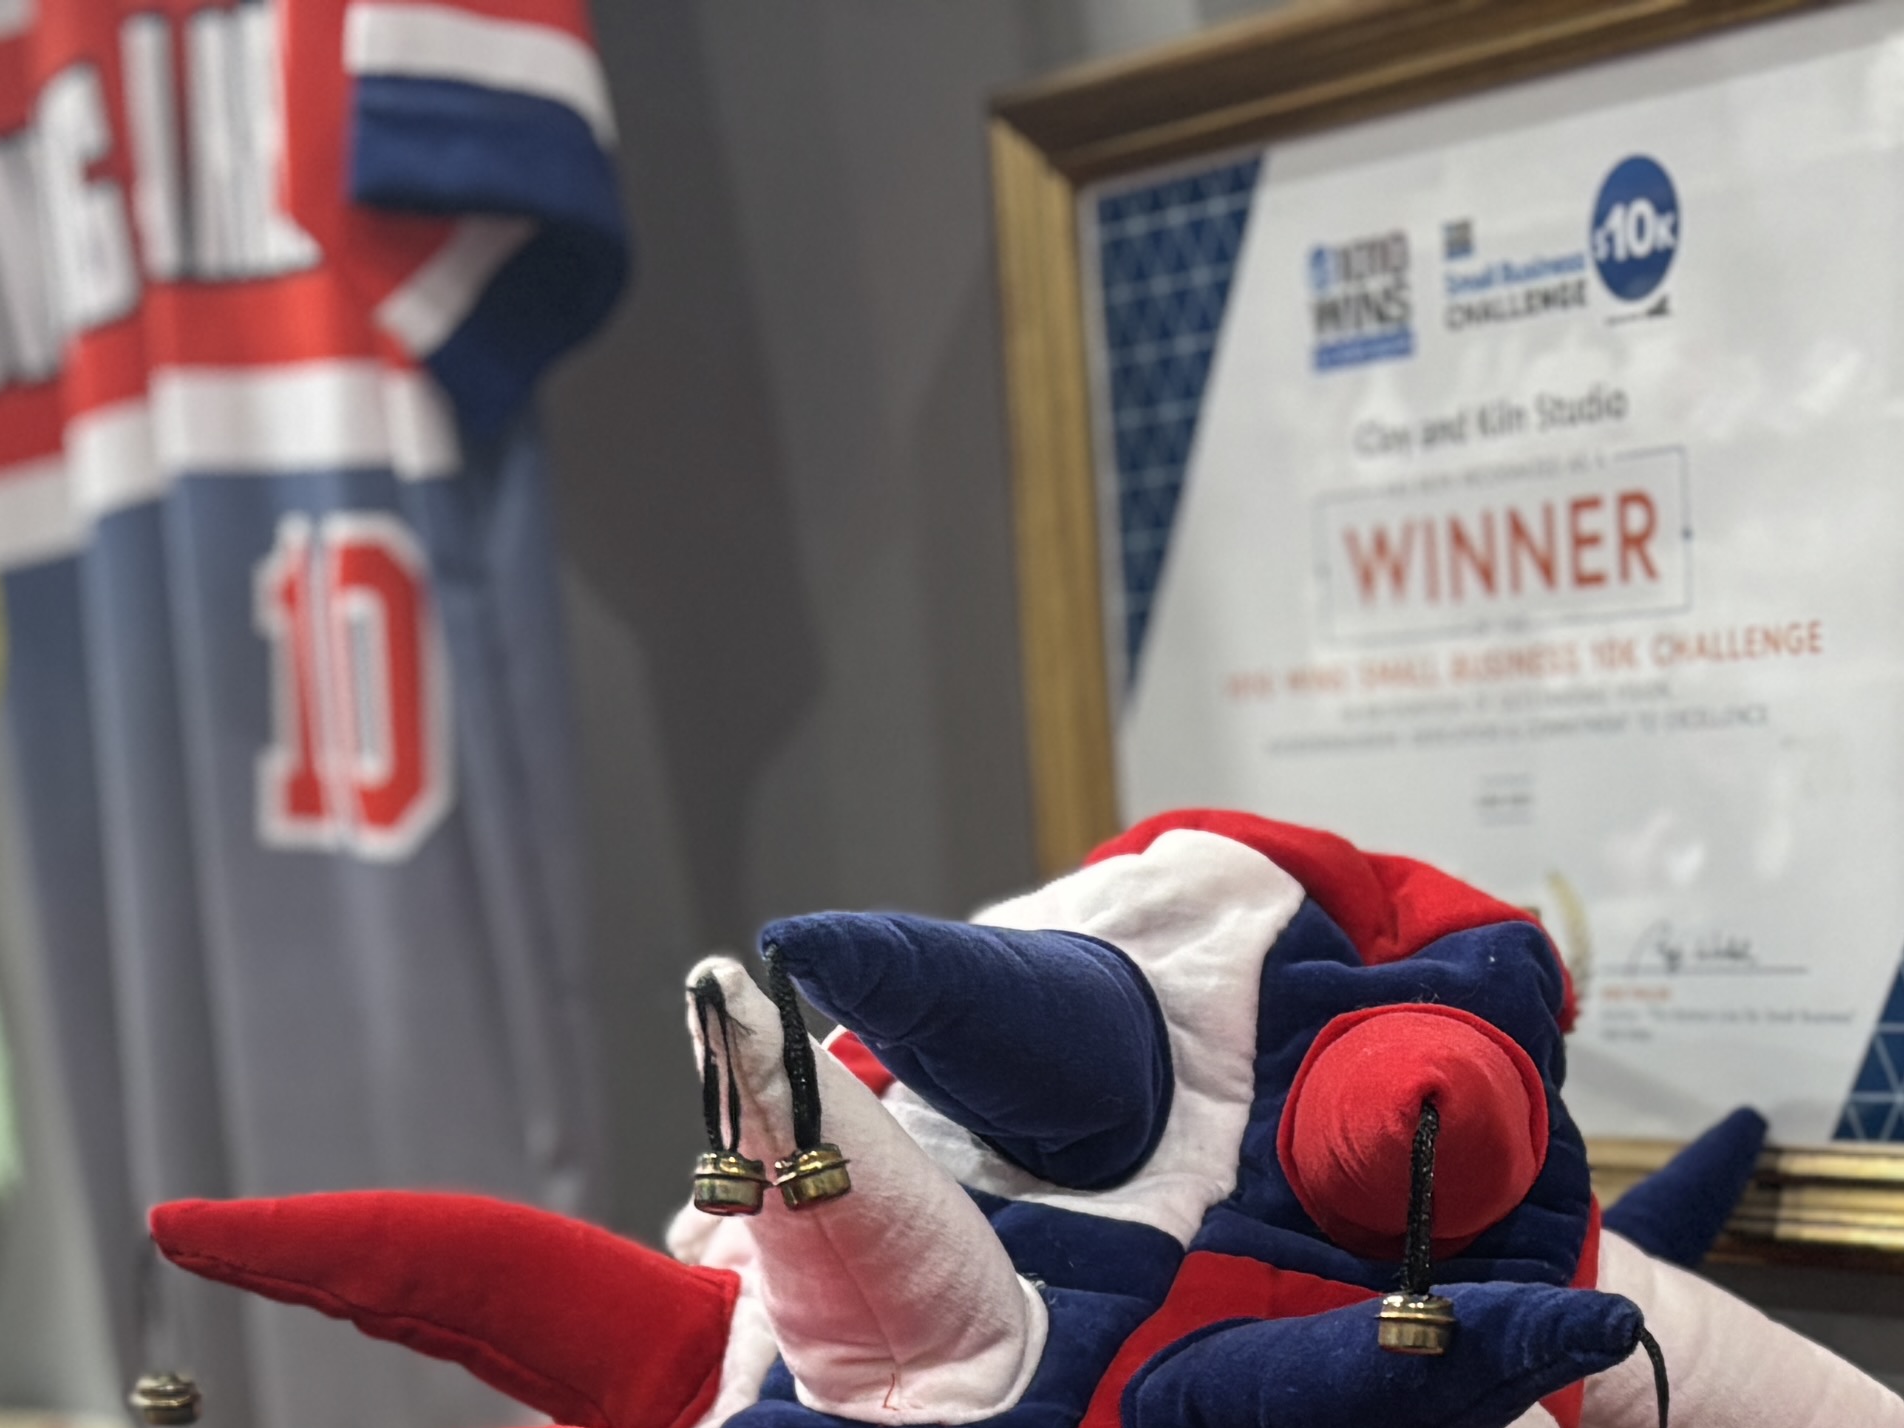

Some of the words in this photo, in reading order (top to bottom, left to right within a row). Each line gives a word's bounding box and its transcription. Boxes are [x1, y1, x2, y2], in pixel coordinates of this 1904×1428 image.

[1503, 251, 1587, 283] Business
[1445, 281, 1588, 331] CHALLENGE
[1534, 385, 1628, 431] Studio
[1342, 487, 1660, 606] WINNER
[1650, 619, 1823, 669] CHALLENGE
